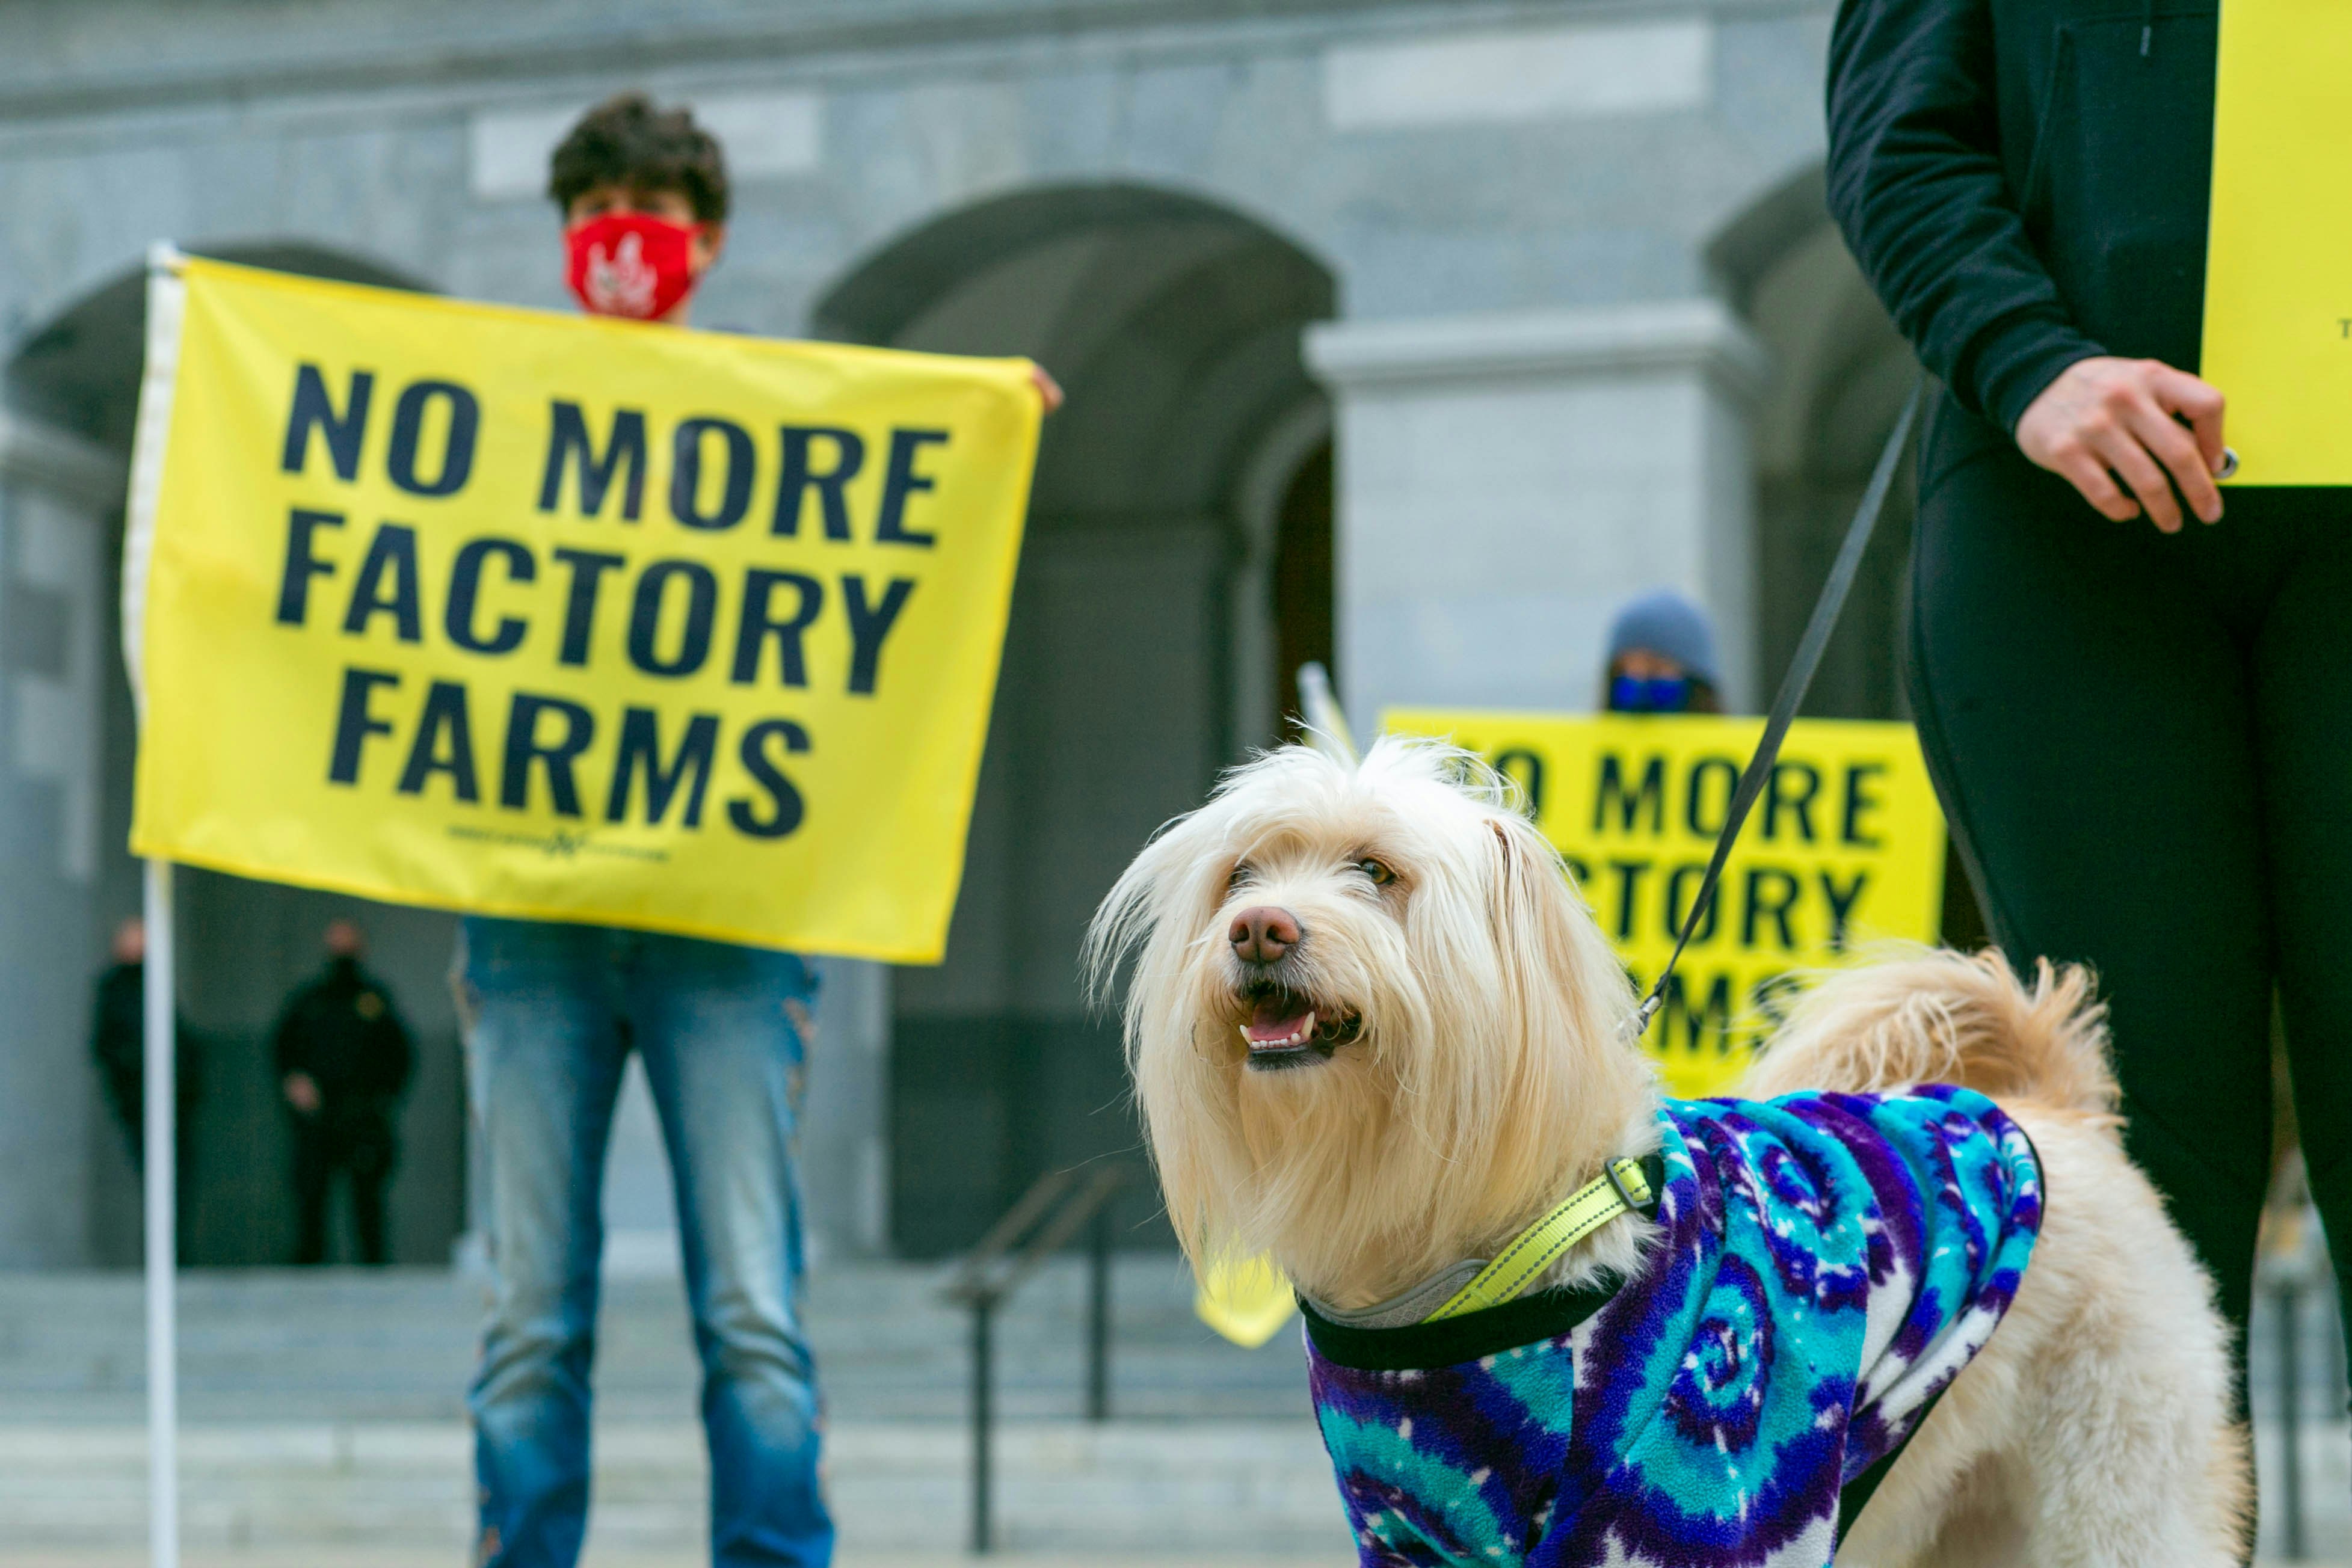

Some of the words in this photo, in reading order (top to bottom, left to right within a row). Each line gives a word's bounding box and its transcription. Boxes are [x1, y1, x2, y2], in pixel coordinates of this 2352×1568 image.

[279, 361, 482, 500] NO
[535, 397, 952, 551] MORE
[273, 505, 918, 698] FACTORY
[326, 664, 814, 843] FARMS
[1456, 740, 1548, 829] O
[1590, 750, 1888, 849] MORE
[1556, 854, 1870, 956] TORY
